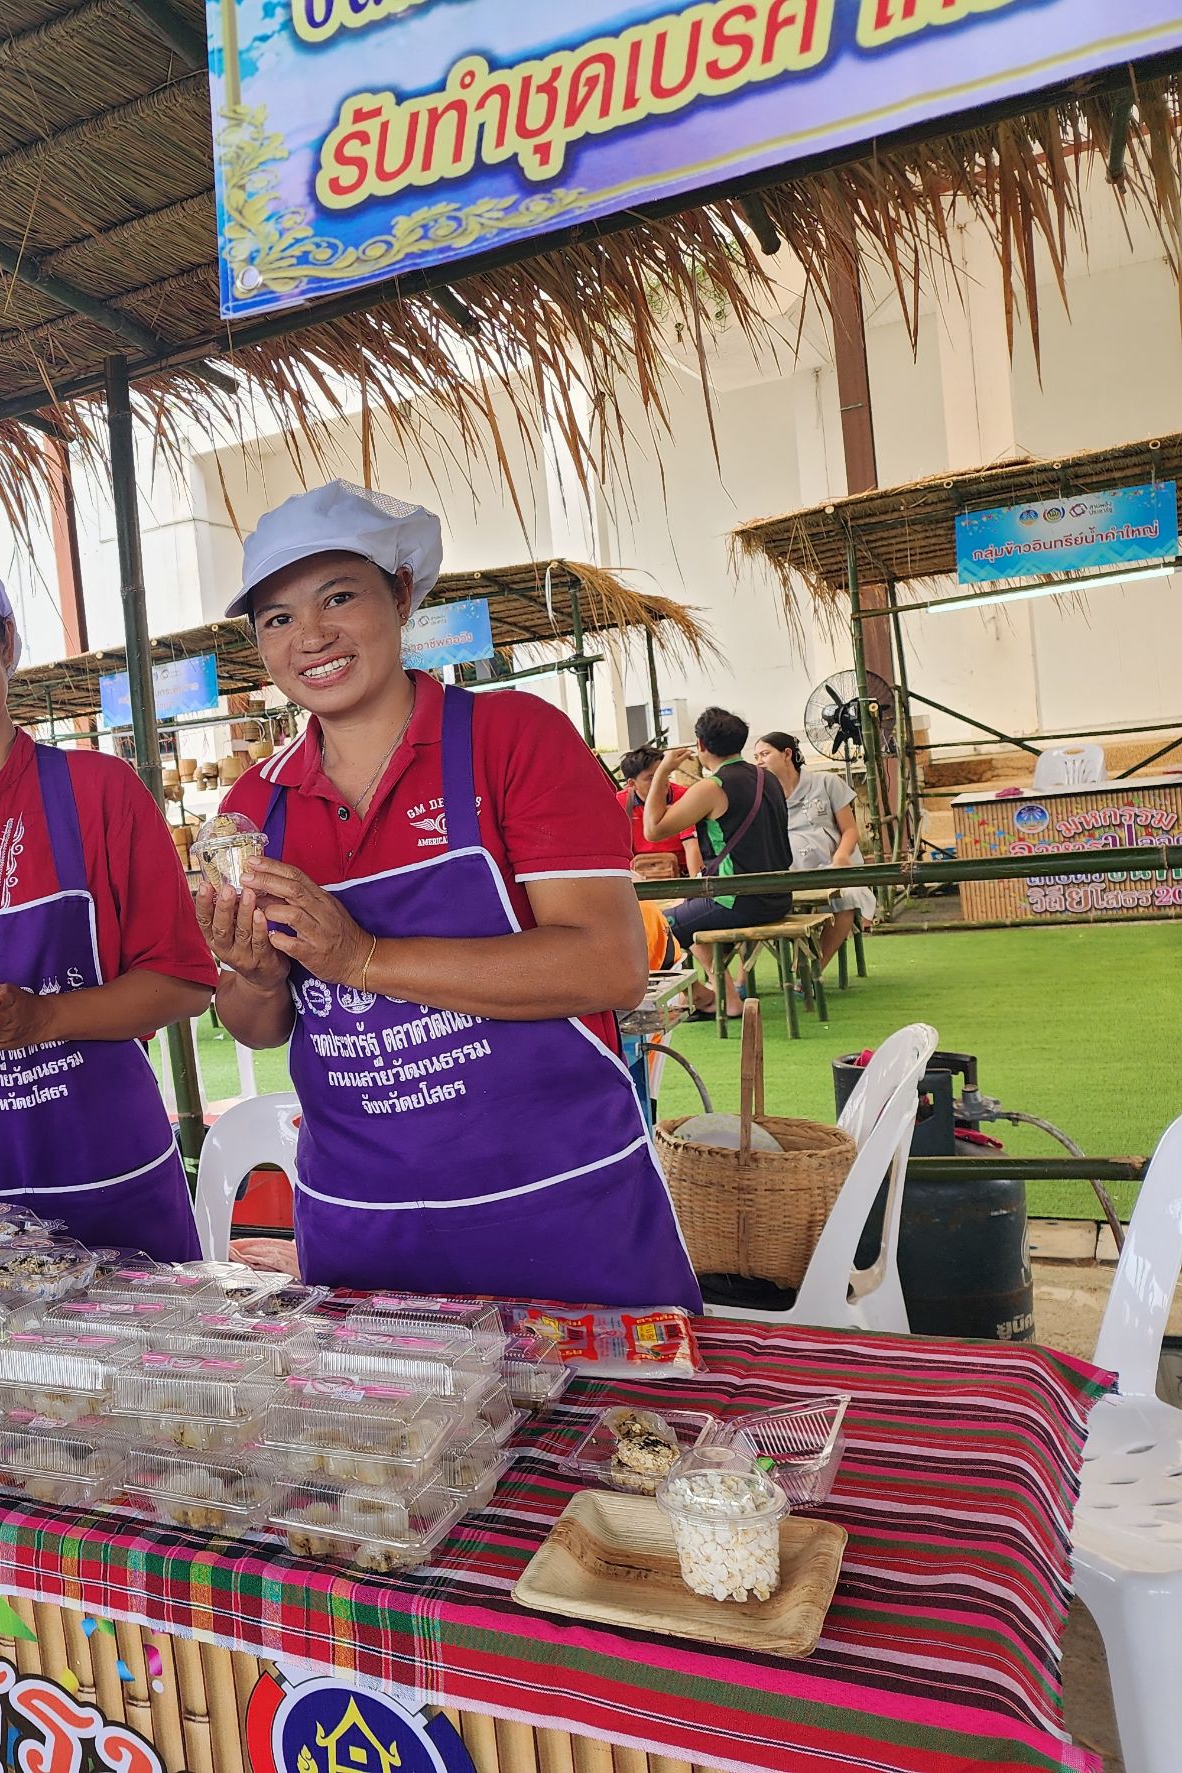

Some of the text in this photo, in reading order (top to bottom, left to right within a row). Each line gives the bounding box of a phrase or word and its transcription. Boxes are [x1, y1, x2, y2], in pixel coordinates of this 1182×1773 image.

[1058, 807, 1177, 837] มหกรรม
[417, 836, 449, 847] AMERICA
[328, 1038, 492, 1088] ถนนสายวัฒนธรรม
[361, 1080, 467, 1114] จังหวัดยโสธร
